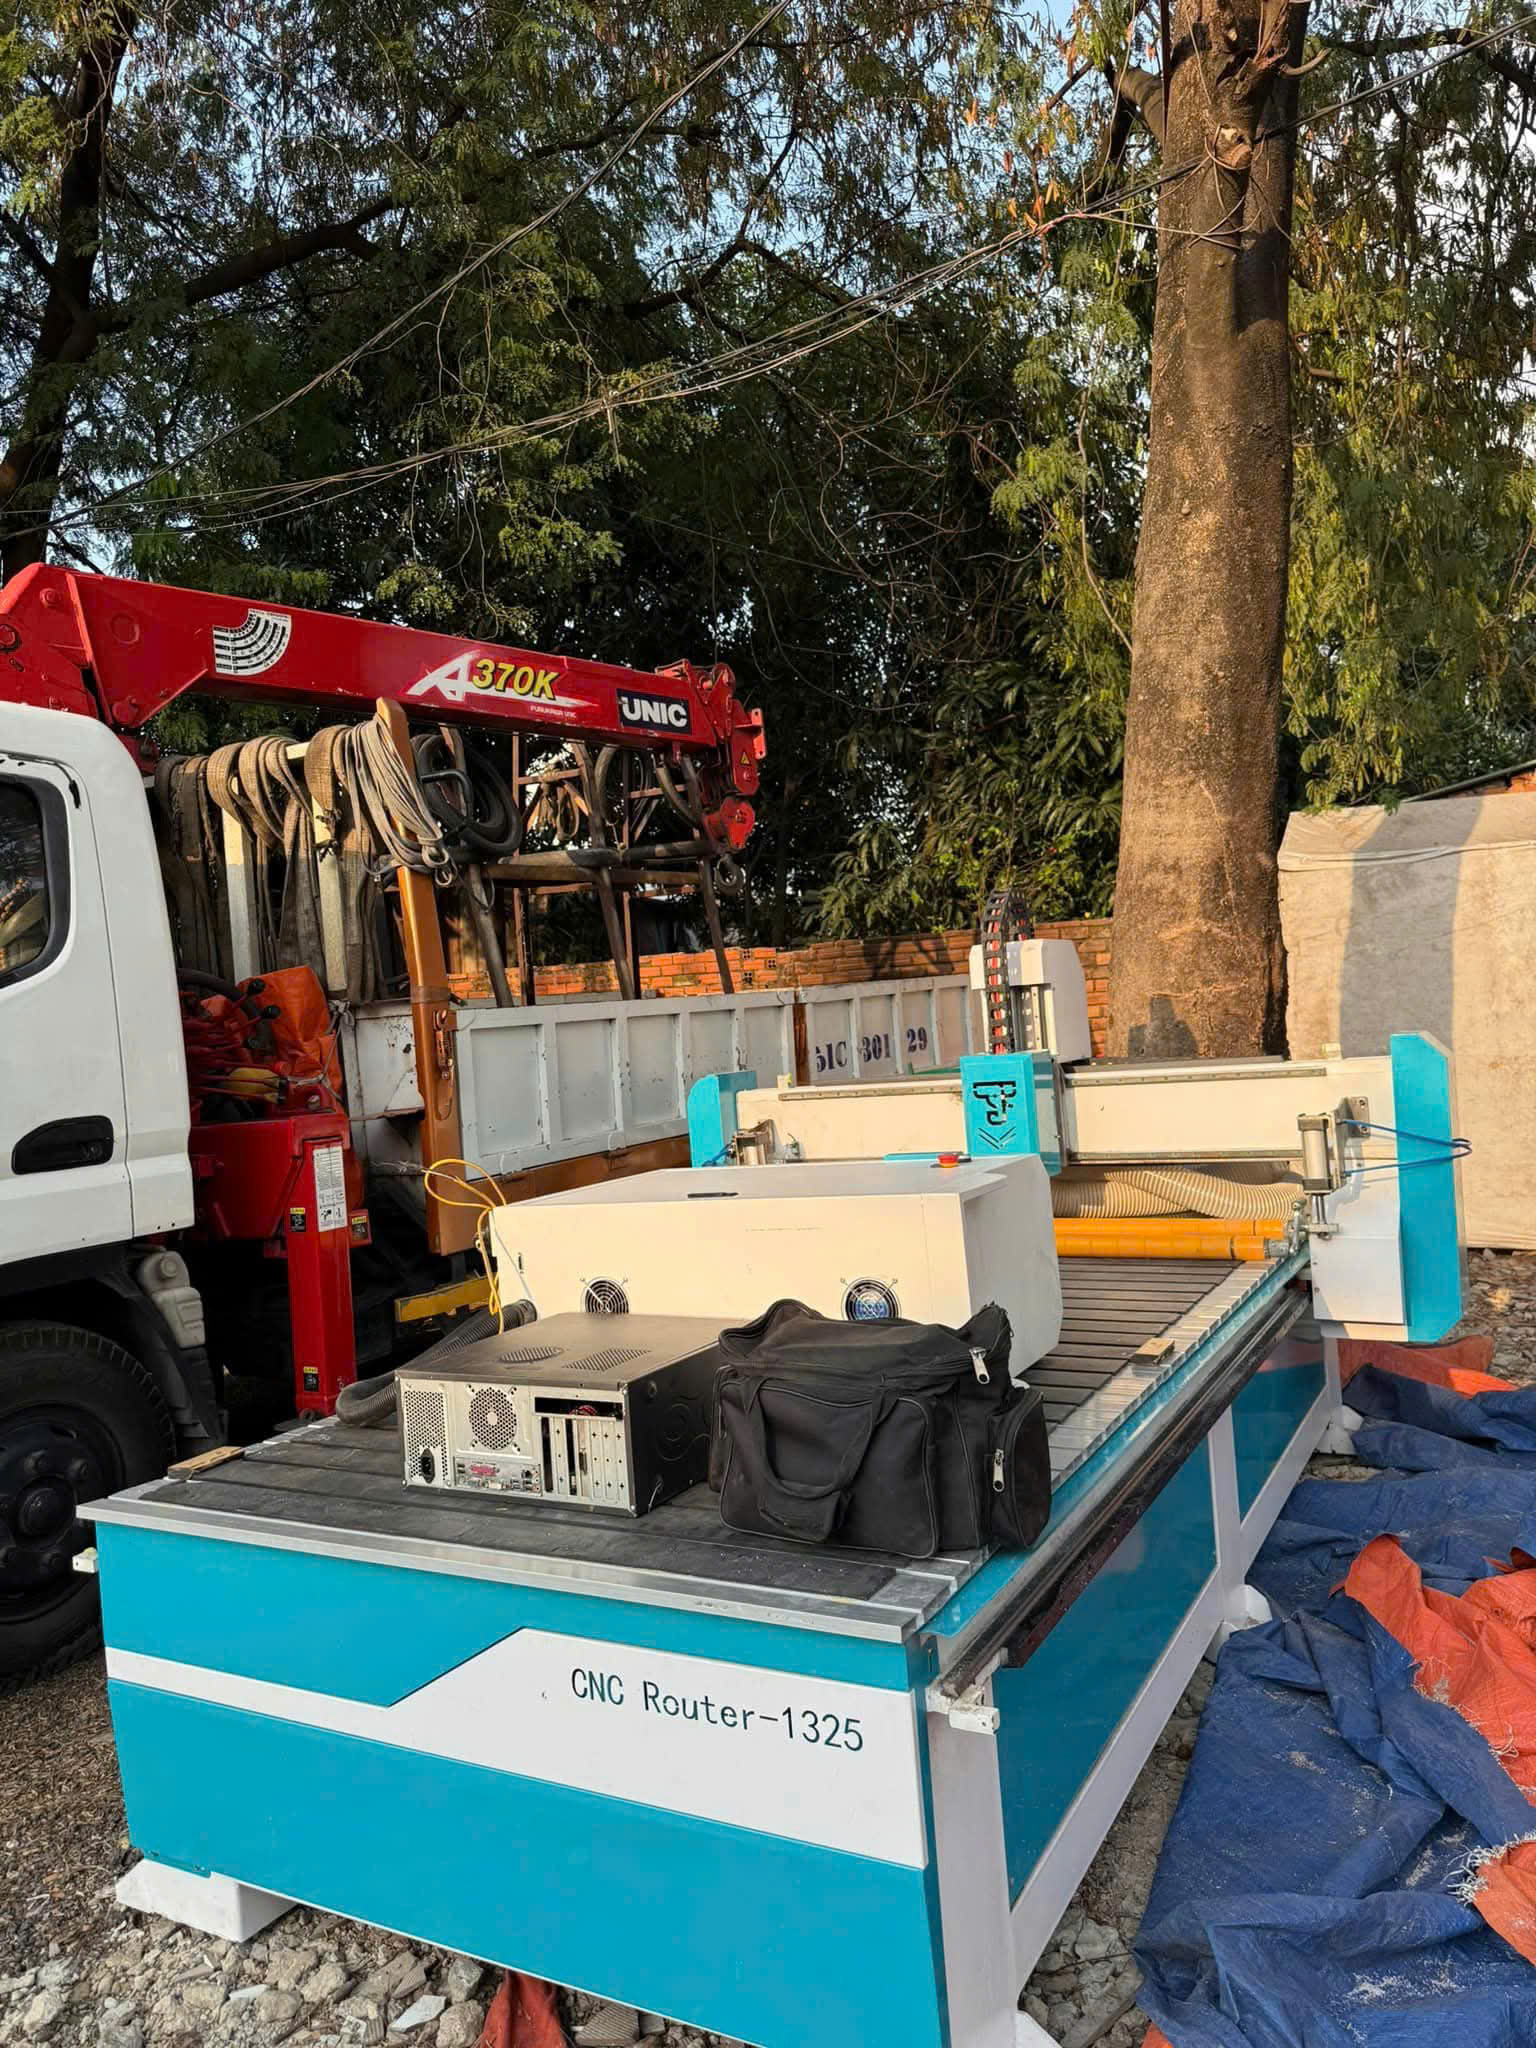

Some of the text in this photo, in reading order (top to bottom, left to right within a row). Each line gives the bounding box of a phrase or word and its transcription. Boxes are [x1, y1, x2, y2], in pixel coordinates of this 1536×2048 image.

[472, 658, 560, 700] 370K
[621, 696, 688, 728] UNIC
[906, 1026, 928, 1053] 29
[571, 1668, 863, 1751] CNC Router-1325
